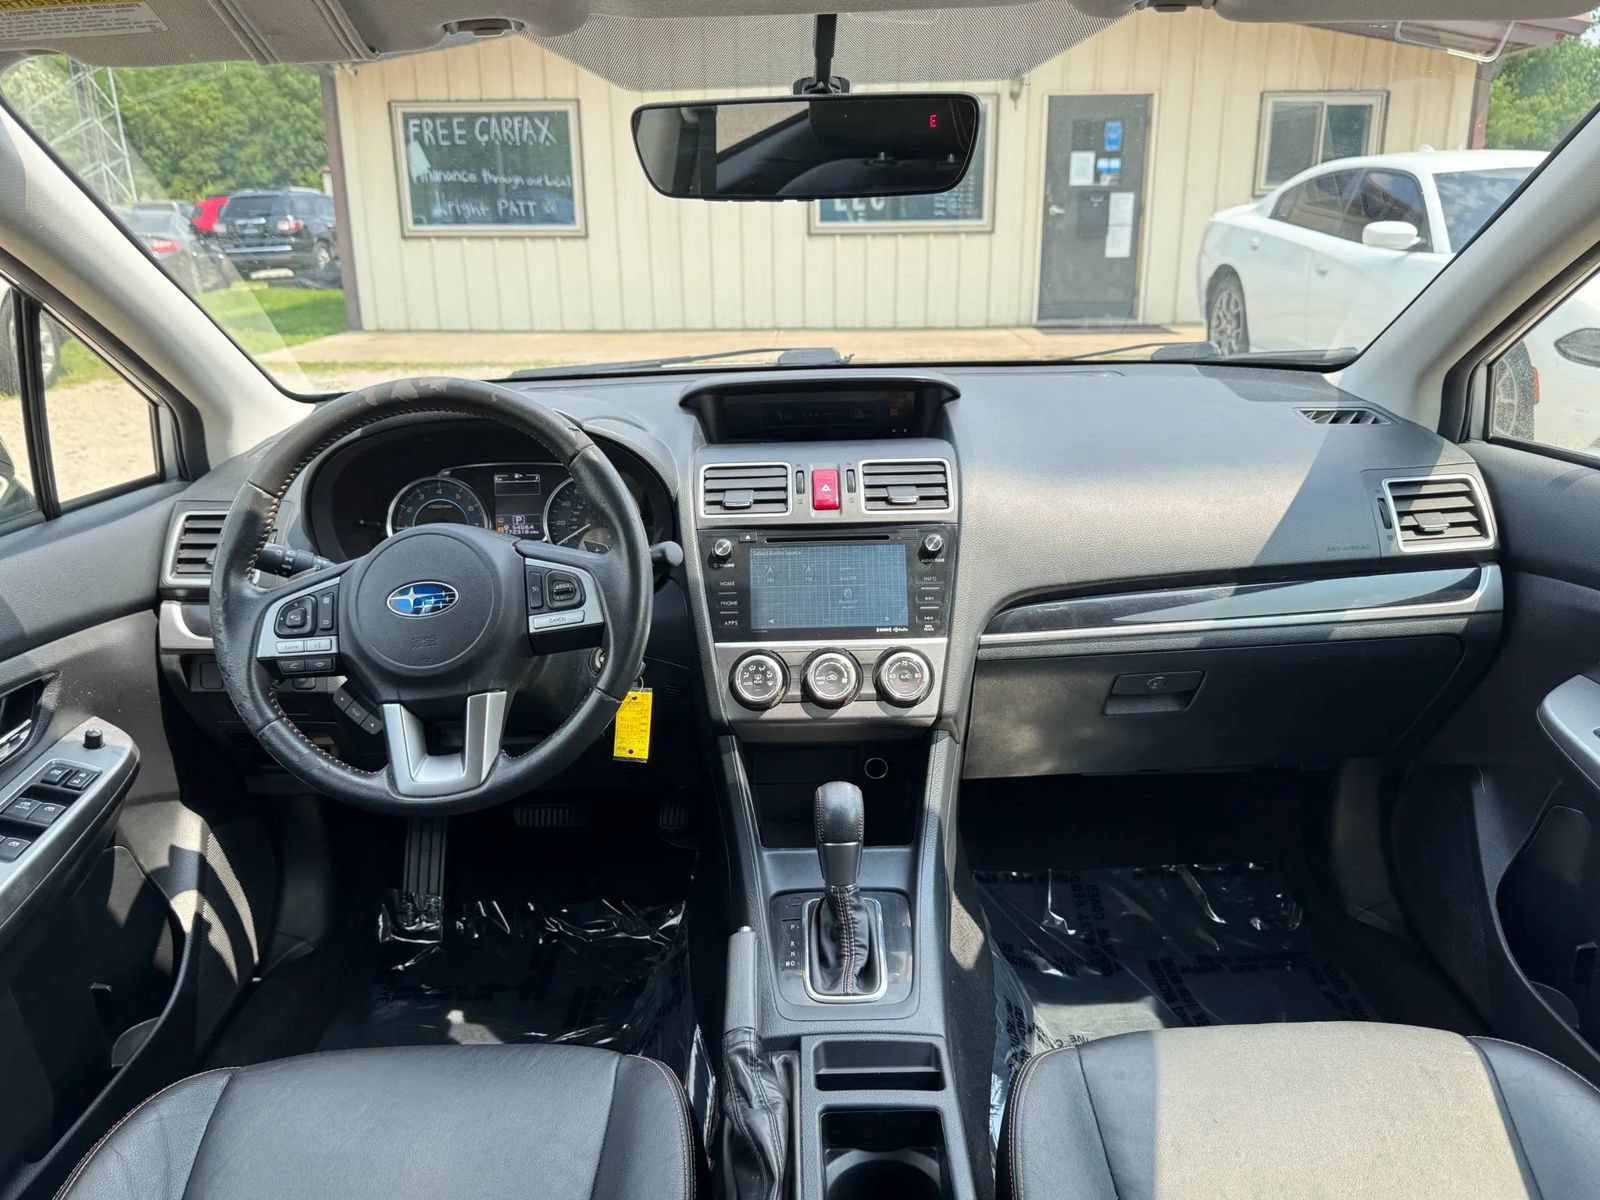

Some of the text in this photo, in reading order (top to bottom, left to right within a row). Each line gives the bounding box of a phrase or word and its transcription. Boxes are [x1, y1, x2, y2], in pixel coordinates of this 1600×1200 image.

[930, 115, 937, 127] E
[408, 115, 557, 147] FREE CARFAX
[497, 198, 537, 217] PATT
